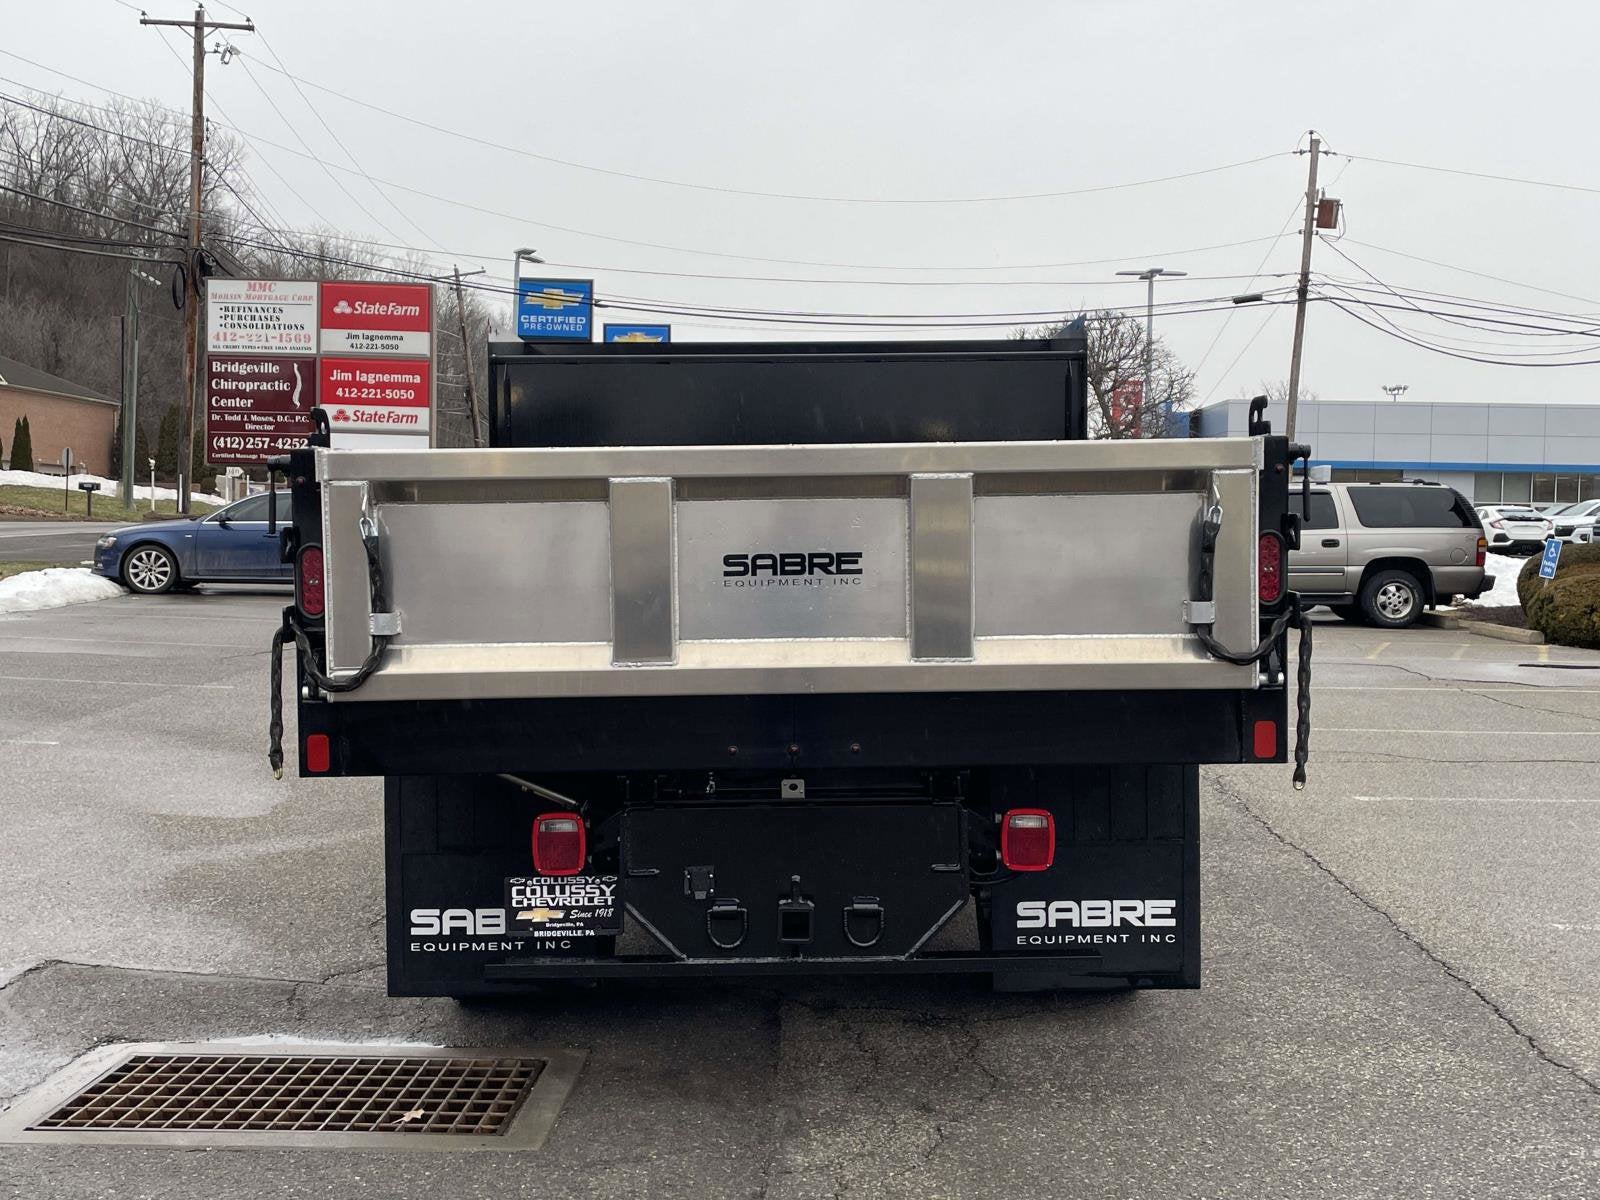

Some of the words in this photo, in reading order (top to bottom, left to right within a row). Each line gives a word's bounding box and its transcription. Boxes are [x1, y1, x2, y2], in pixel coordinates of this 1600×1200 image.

[246, 281, 277, 293] MMC
[245, 293, 289, 302] MORTGAGE
[223, 305, 284, 314] REFINANCES
[223, 314, 281, 322] PURCHASES
[520, 315, 586, 324] CERTIFIED
[223, 322, 305, 331] CONSOLIDATIONS
[523, 323, 583, 331] PRE-OWNED
[212, 331, 312, 344] 412-221-1569
[345, 332, 360, 341] Jim
[362, 333, 404, 342] Iagnemma
[349, 342, 400, 351] 412-221-5050
[211, 361, 280, 376] Bridgeville
[329, 369, 352, 381] Jim
[355, 370, 421, 385] Iagnemma
[211, 378, 291, 393] Chiropractic
[335, 387, 415, 400] 412-221-5050
[211, 395, 254, 408] Center
[211, 413, 223, 421] Dr.
[223, 414, 242, 422] Todd
[243, 414, 250, 422] J.
[250, 414, 276, 423] Moses,
[244, 422, 275, 431] Director
[722, 552, 863, 577] SABRE
[722, 578, 824, 588] EQUIPMENT
[832, 577, 862, 586] INC
[532, 876, 596, 885] COLUSSY
[511, 884, 617, 899] COLUSSY
[511, 896, 616, 908] CHEVROLET
[569, 909, 593, 919] Since
[594, 908, 615, 918] 1918
[1016, 899, 1177, 928] SABRE
[410, 908, 506, 936] SAB
[1016, 935, 1130, 945] EQUIPMENT
[1141, 934, 1177, 943] INC
[410, 941, 525, 952] EQUIPMENT
[536, 940, 571, 950] INC
